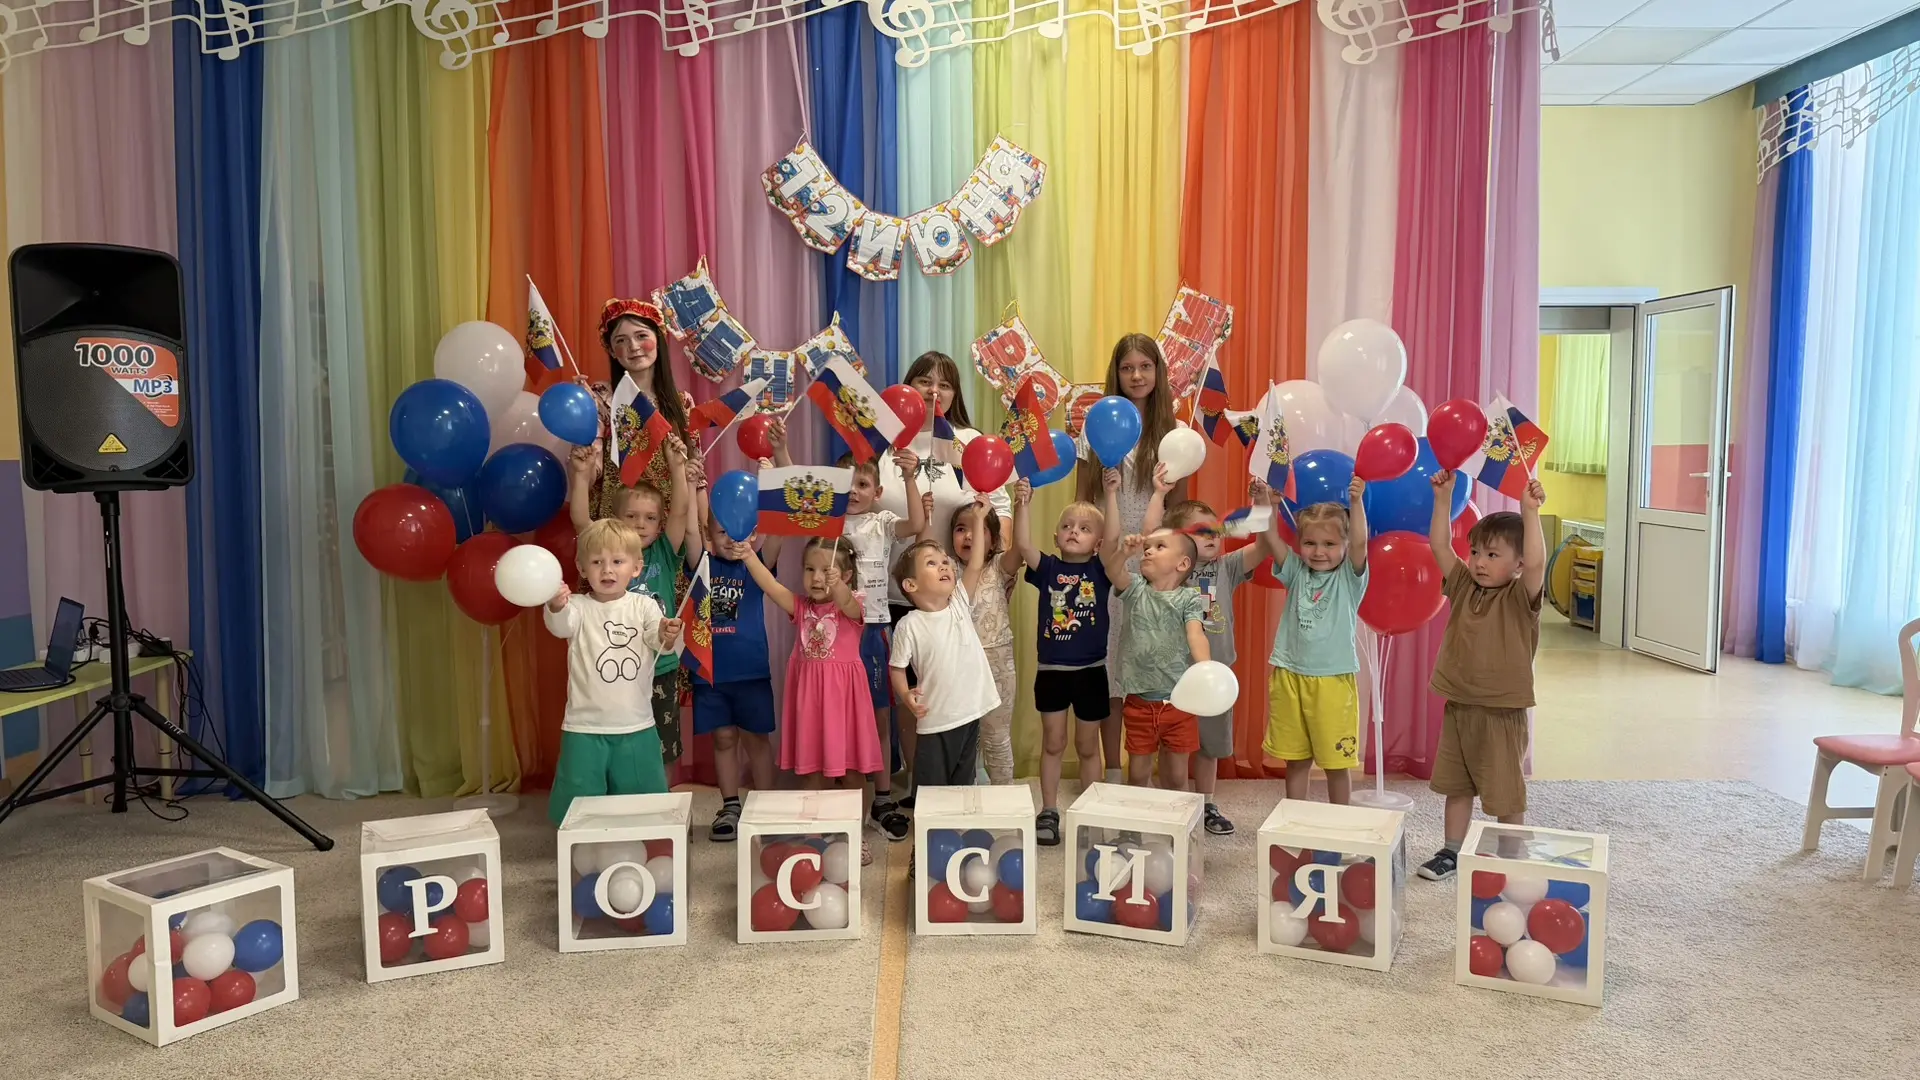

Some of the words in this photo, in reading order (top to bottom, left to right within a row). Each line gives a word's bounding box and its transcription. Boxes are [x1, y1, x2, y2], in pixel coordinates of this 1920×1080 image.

[779, 156, 849, 245] 12
[856, 149, 1039, 269] ИЮНЯ
[74, 343, 156, 369] 1000
[110, 367, 148, 375] WATTS
[133, 379, 173, 394] MP3
[727, 578, 743, 587] YOU
[711, 585, 745, 600] EADY
